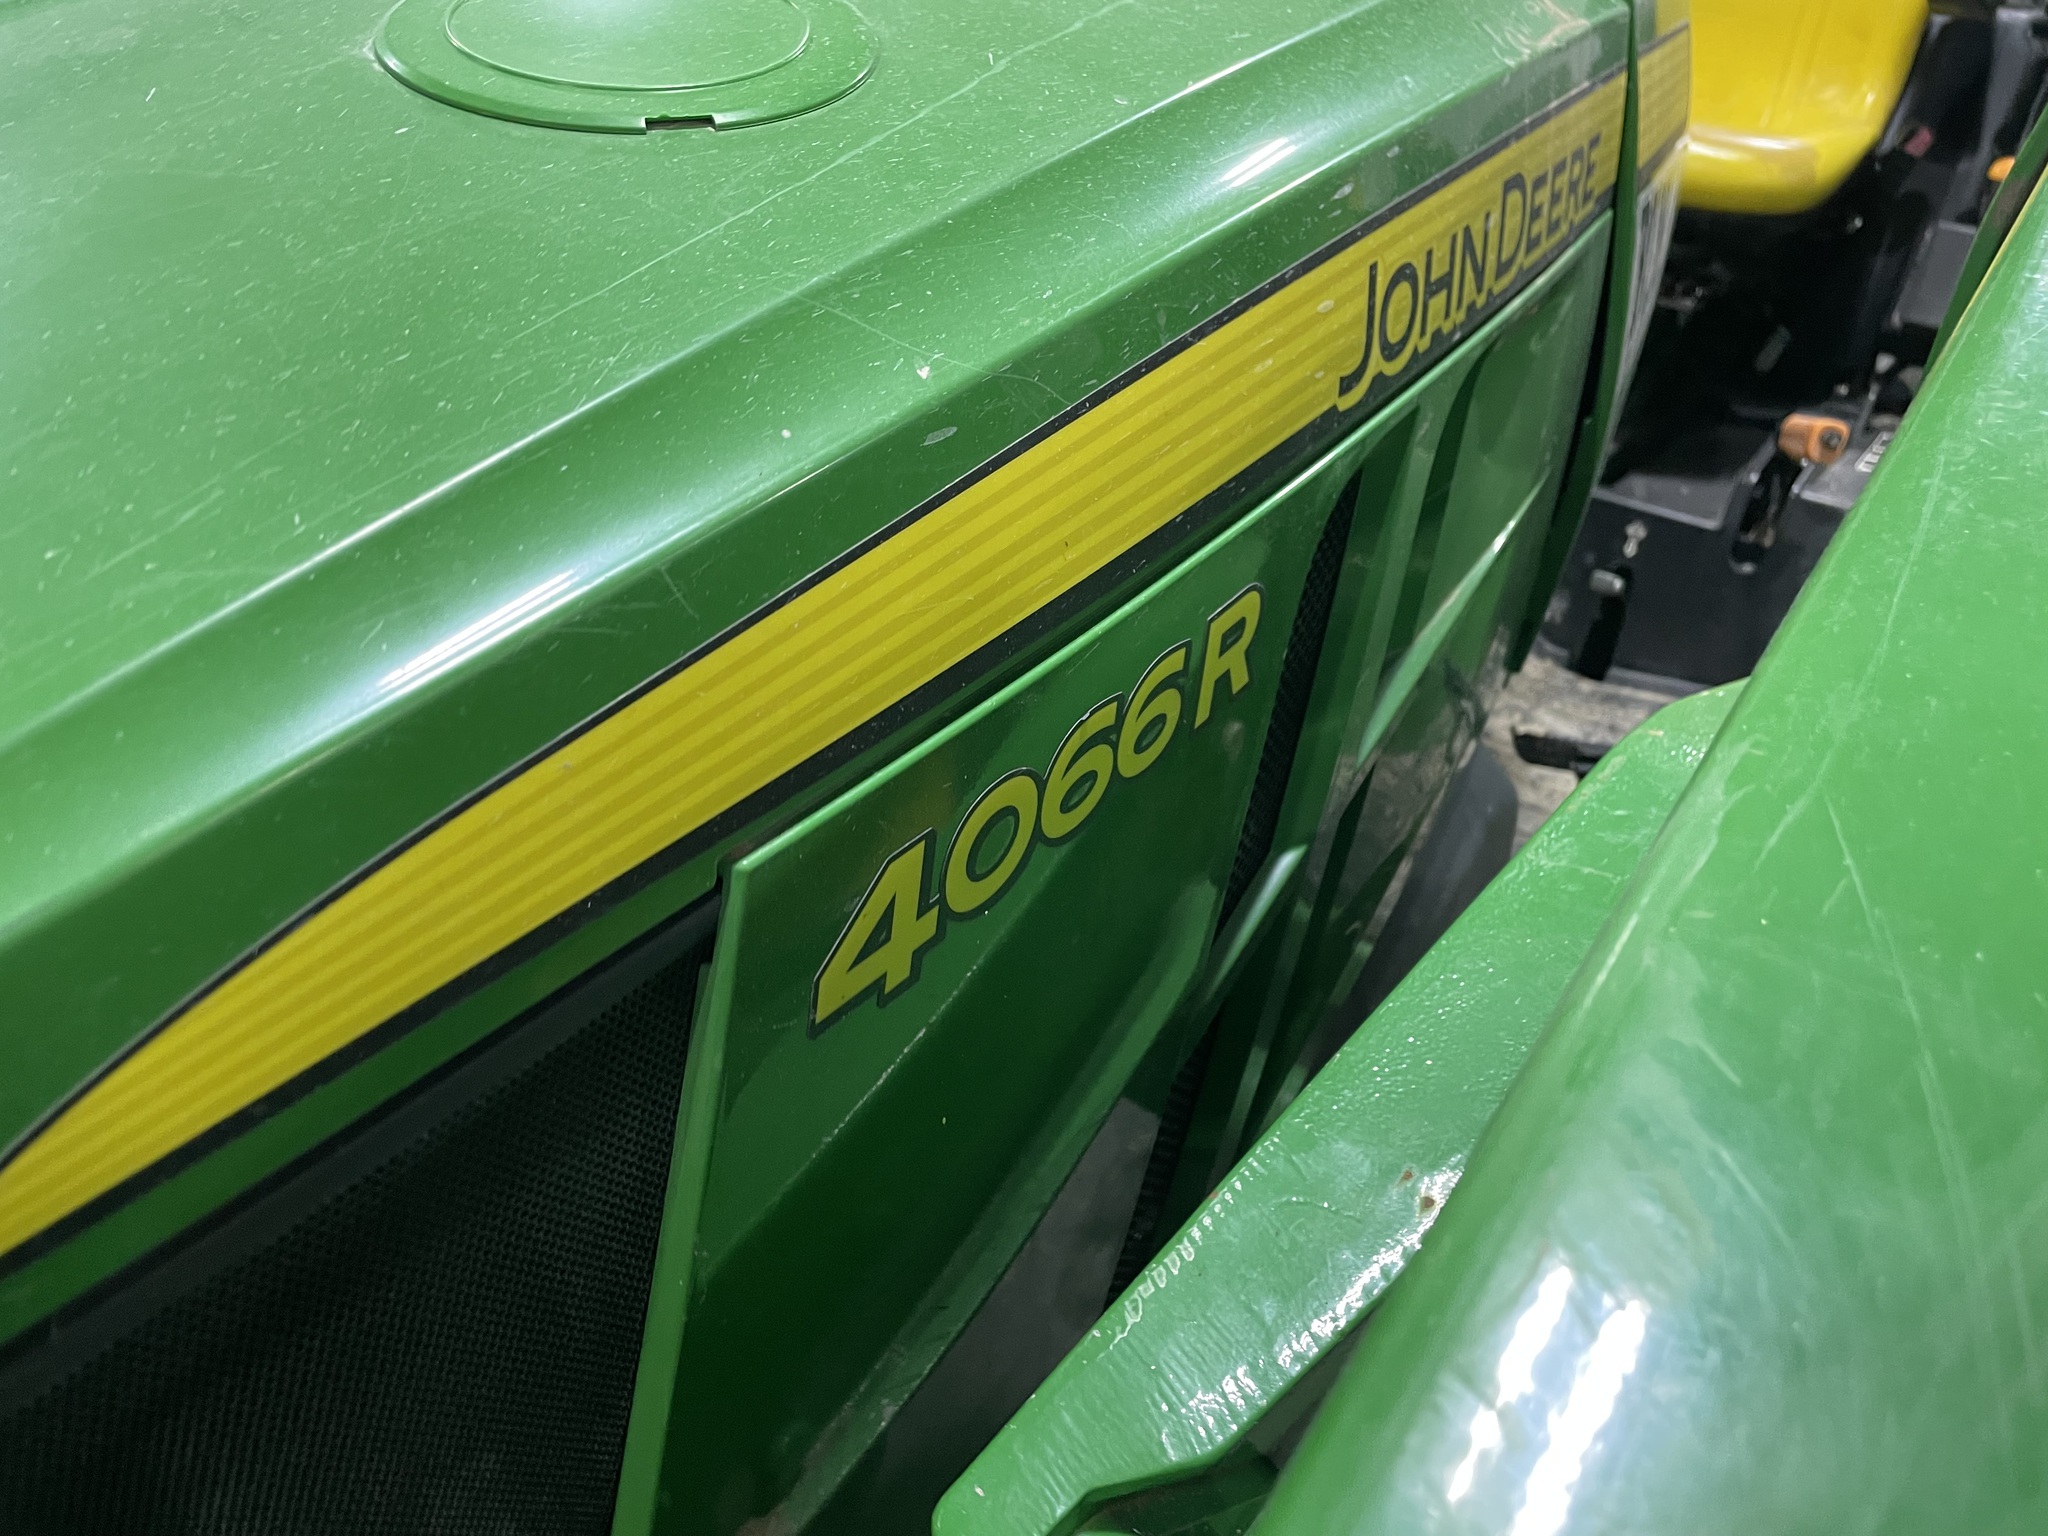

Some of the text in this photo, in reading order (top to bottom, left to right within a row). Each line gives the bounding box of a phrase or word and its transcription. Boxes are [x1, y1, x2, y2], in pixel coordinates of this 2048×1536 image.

[1338, 211, 1492, 400] JOHN
[1496, 132, 1601, 276] DEERE
[812, 587, 1263, 1030] 4066R
